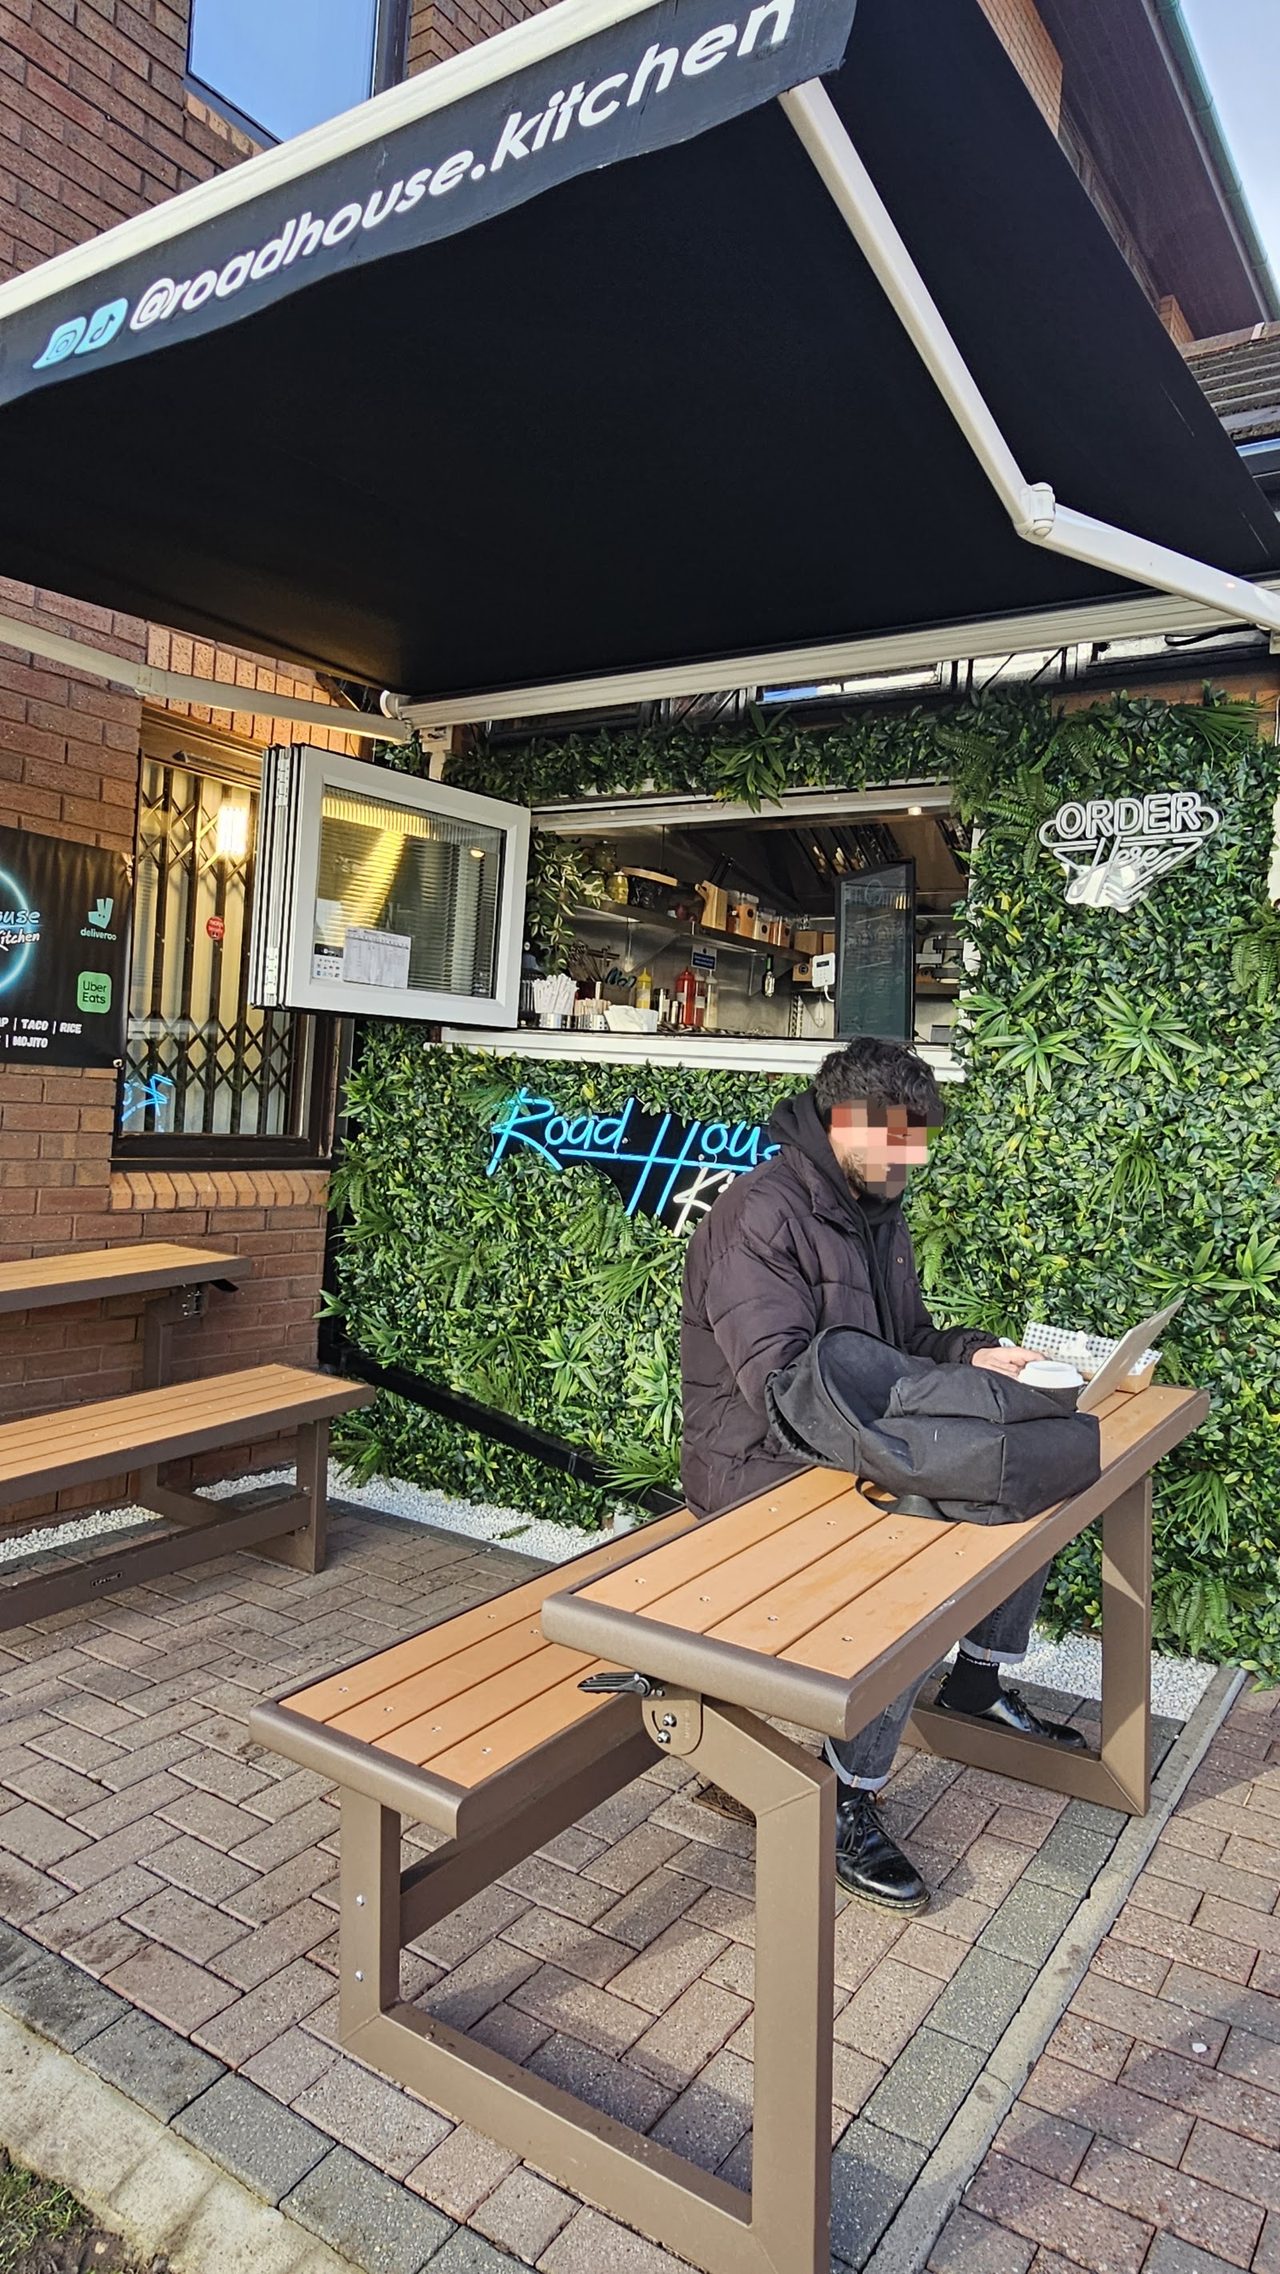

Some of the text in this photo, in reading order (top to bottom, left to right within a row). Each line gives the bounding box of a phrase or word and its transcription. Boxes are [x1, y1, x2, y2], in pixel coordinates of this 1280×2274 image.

[129, 0, 797, 331] @roadhouse.kitchen
[1055, 791, 1201, 840] ORDER
[1064, 836, 1186, 904] Here
[80, 927, 118, 941] deliveroo
[82, 980, 107, 993] Uber
[82, 992, 107, 1005] Eats
[21, 1018, 49, 1031] TACO
[59, 1022, 83, 1035] RICE
[12, 1035, 48, 1049] MOJITO
[485, 1086, 635, 1177] Road
